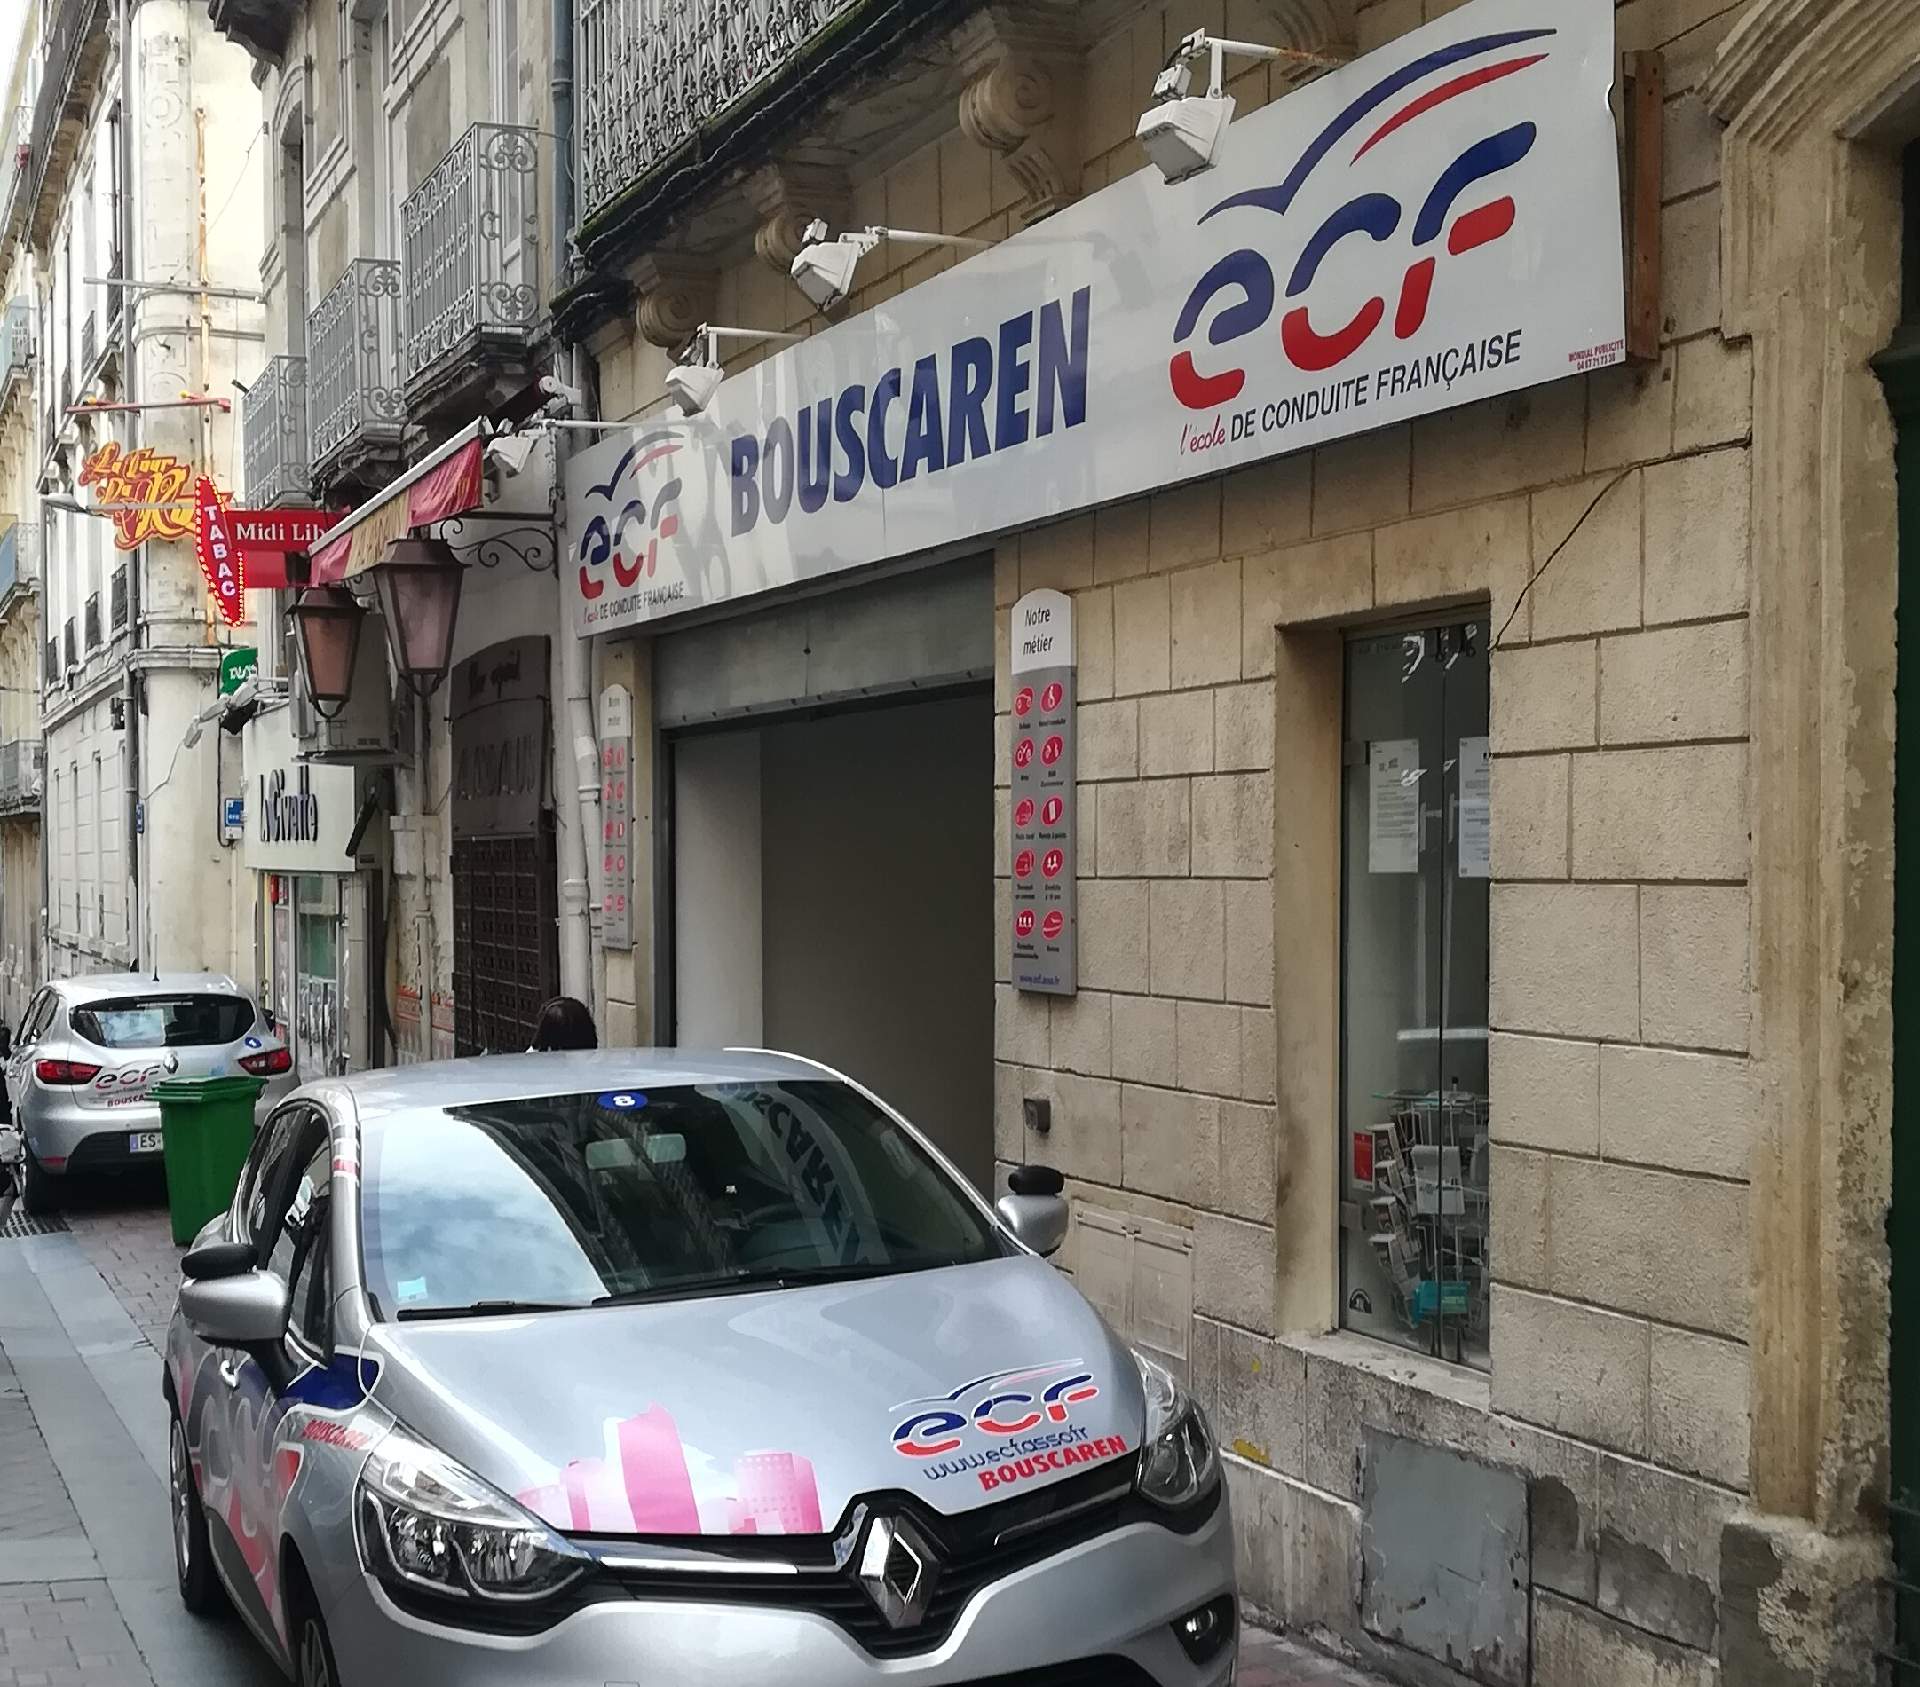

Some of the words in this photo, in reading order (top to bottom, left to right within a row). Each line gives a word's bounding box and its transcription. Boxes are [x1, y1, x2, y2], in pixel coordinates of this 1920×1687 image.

[1230, 408, 1256, 442] DE
[1261, 374, 1370, 433] CONDUITE
[1376, 328, 1523, 400] FRANÇAISE
[730, 285, 1091, 538] BOUSCAREN
[204, 505, 236, 597] TABAC
[236, 523, 285, 541] Midi
[292, 523, 325, 541] Lib
[1024, 607, 1051, 627] Notre
[1022, 634, 1053, 656] métier
[107, 1094, 145, 1108] BOUSCA
[978, 1434, 1127, 1492] BOUSCAREN
